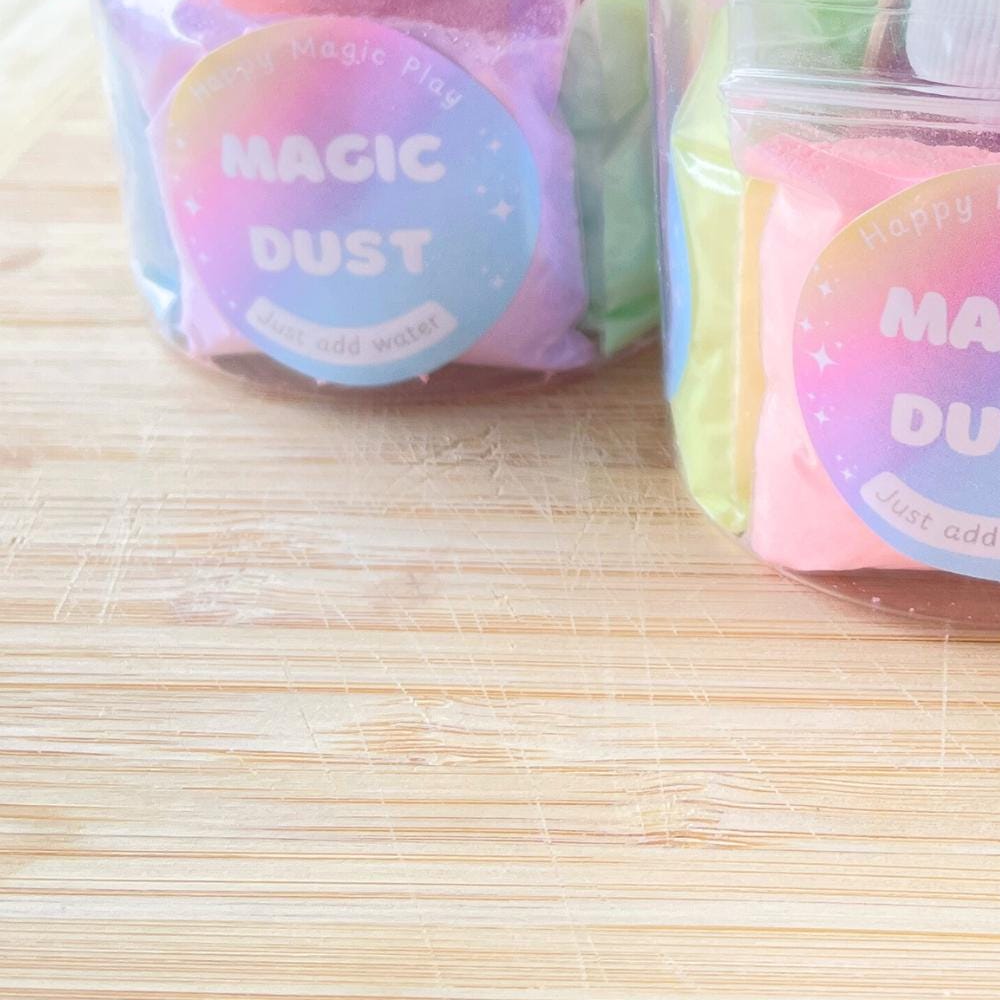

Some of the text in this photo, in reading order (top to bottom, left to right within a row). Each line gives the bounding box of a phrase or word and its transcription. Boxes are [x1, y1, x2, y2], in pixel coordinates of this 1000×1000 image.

[290, 38, 386, 65] Magic
[402, 55, 464, 110] Play
[220, 133, 446, 184] MAGIC
[859, 193, 974, 250] Happy
[250, 225, 432, 277] DUST
[256, 306, 440, 356] Just add water
[875, 486, 934, 532] Just
[943, 524, 999, 548] add
